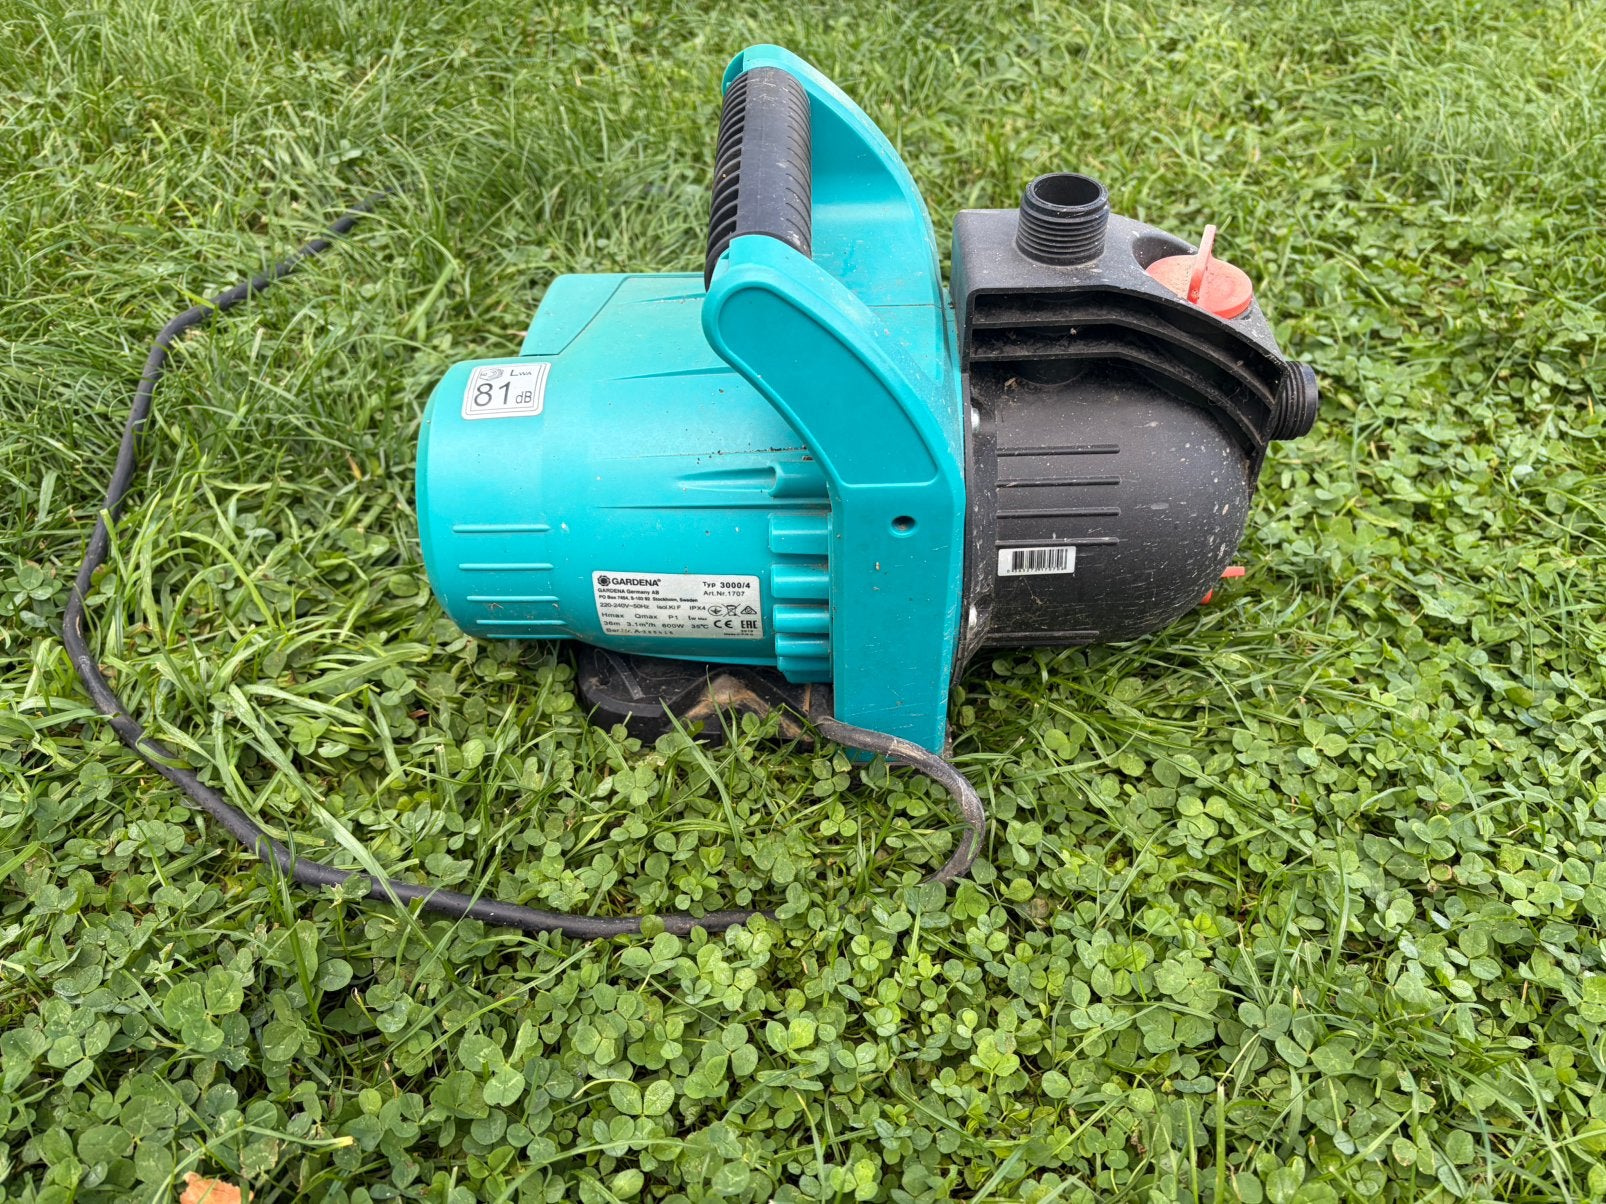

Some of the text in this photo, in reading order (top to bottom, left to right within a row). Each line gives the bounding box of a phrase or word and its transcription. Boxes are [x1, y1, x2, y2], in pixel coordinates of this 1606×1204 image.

[474, 381, 533, 407] 81 dB
[612, 578, 659, 587] GARDENA
